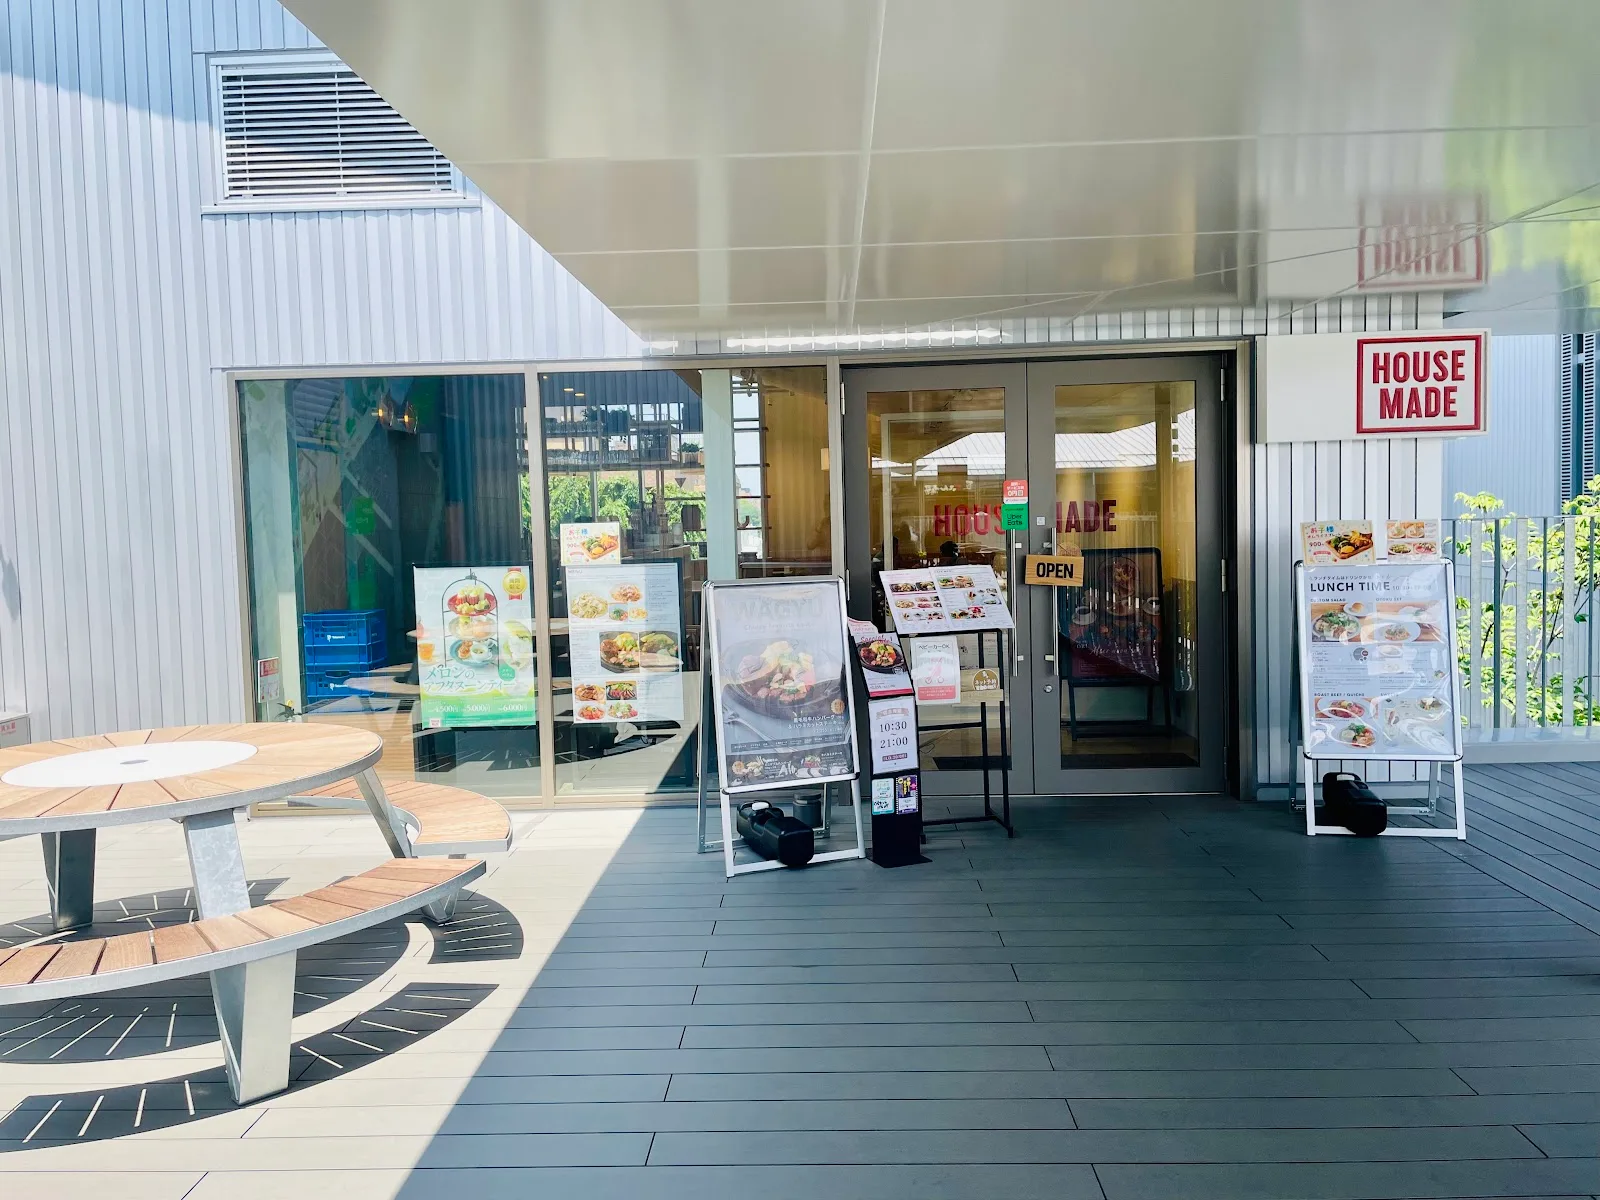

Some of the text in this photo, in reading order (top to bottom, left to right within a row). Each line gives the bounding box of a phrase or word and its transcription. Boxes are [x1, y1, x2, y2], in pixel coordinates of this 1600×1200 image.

[1372, 350, 1466, 384] HOUSE
[1379, 386, 1458, 420] MADE
[934, 504, 1006, 537] HOUS
[1036, 562, 1074, 579] OPEN
[1310, 582, 1354, 592] LUNCH
[1359, 581, 1391, 591] TIME
[425, 665, 475, 681] メロンの
[424, 680, 516, 693] アフタヌーンティー
[880, 720, 907, 732] 10:30
[880, 736, 908, 749] 21:00
